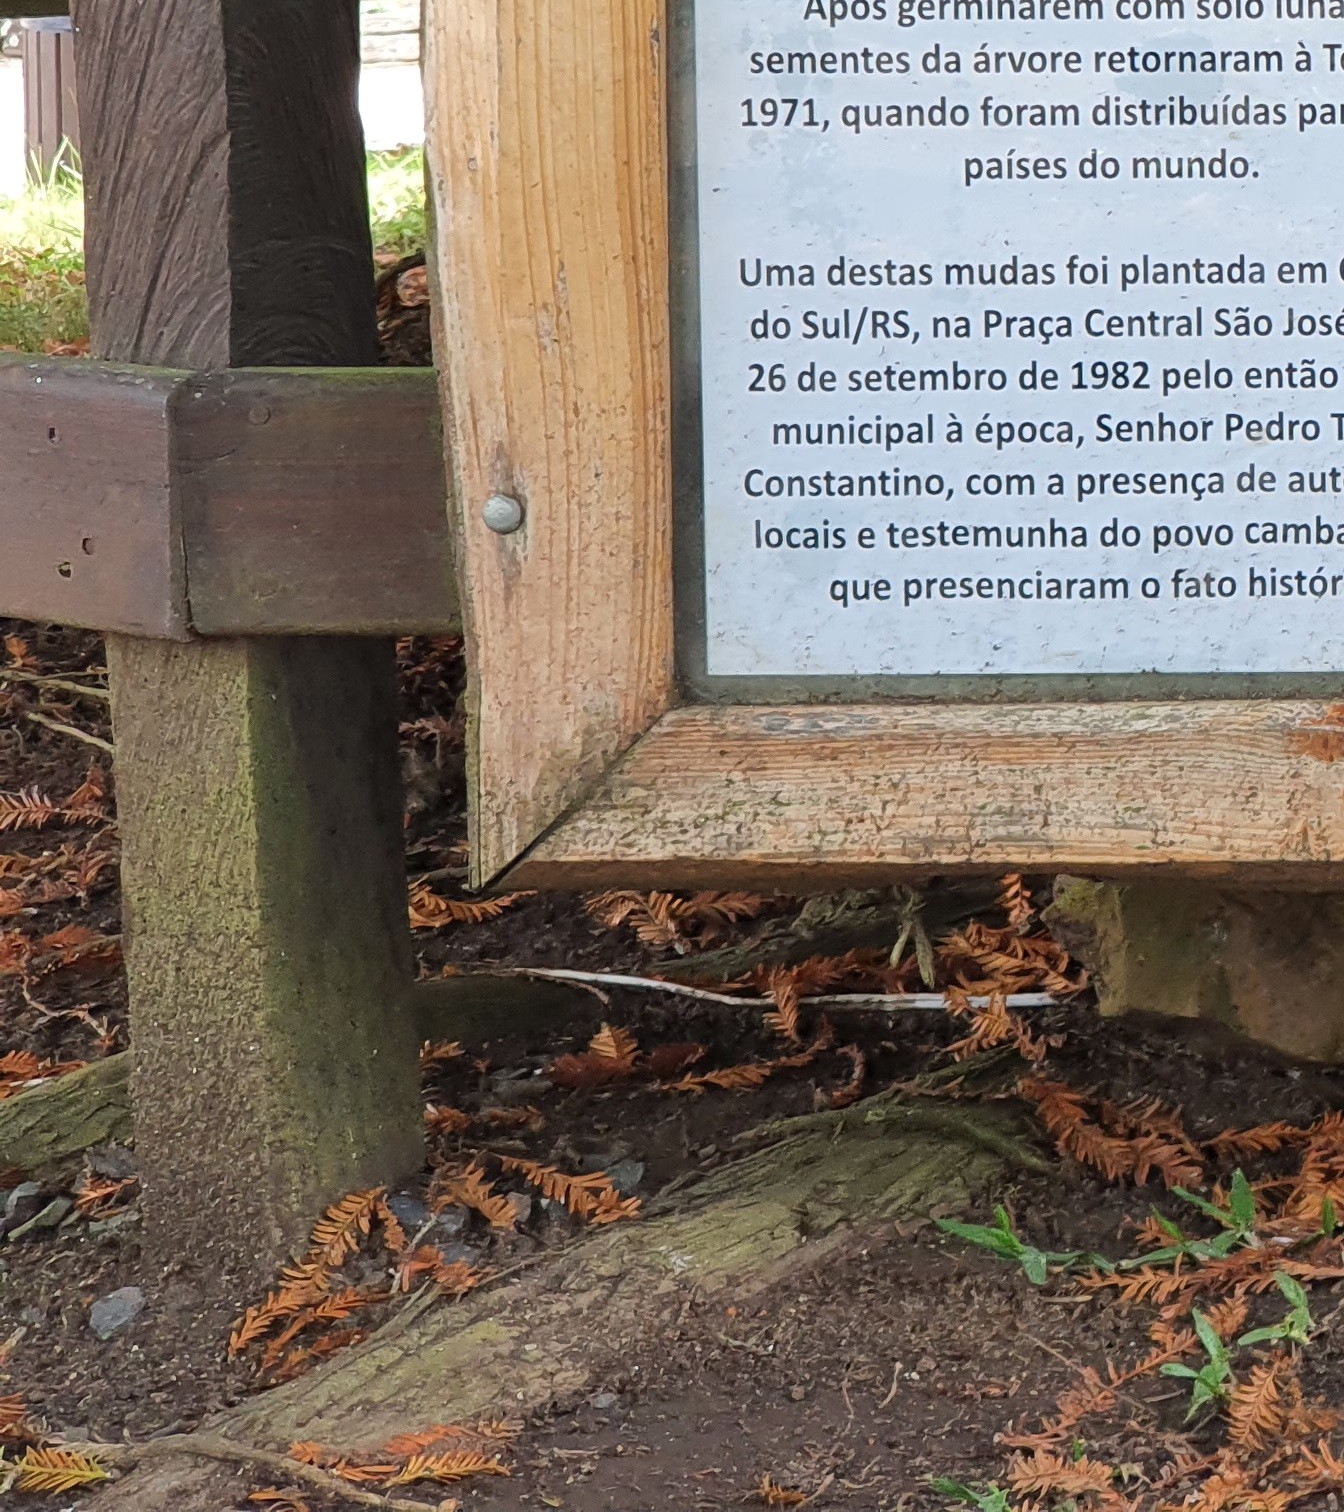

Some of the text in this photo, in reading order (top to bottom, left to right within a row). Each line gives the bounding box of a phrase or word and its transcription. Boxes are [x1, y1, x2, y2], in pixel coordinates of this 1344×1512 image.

[750, 47, 911, 74] sementes
[921, 42, 961, 74] da
[973, 42, 1082, 74] árvore
[1094, 46, 1283, 74] retornaram
[1294, 41, 1312, 73] à
[741, 97, 830, 133] 1971,
[841, 95, 970, 135] quando
[979, 95, 1080, 127] foram
[1092, 94, 1287, 126] distribuídas
[964, 148, 1259, 187] países do mundo.
[739, 257, 815, 287] Uma
[827, 255, 933, 287] destas
[944, 255, 1056, 286] mudas
[1065, 254, 1108, 285] foi
[1120, 253, 1265, 293] plantada
[1277, 261, 1327, 284] em
[750, 308, 792, 340] do
[801, 306, 920, 346] Sul/RS,
[932, 316, 971, 339] na
[984, 309, 1073, 346] Praça
[1084, 306, 1203, 338] Central
[1213, 306, 1273, 337] São
[748, 363, 787, 393] 26
[797, 361, 837, 393] de
[848, 360, 1007, 392] setembro
[1018, 360, 1059, 391] de
[1071, 360, 1151, 390] 1982
[1162, 358, 1234, 397] pelo
[1244, 358, 1339, 389] então
[773, 413, 934, 452] municipal
[945, 412, 963, 444] à
[975, 412, 1085, 451] época,
[1095, 411, 1214, 443] Senhor
[1225, 411, 1321, 442] Pedro
[744, 466, 954, 502] Constantino,
[966, 473, 1035, 496] com
[1047, 473, 1065, 496] a
[1077, 472, 1225, 503] presença
[1236, 462, 1277, 493] de
[754, 518, 847, 550] locais
[857, 527, 876, 549] e
[886, 517, 1088, 549] testemunha
[1099, 516, 1141, 548] do
[1153, 524, 1234, 554] povo
[829, 578, 892, 609] que
[903, 570, 1129, 607] presenciaram
[1141, 577, 1161, 599] o
[1170, 567, 1237, 599] fato
